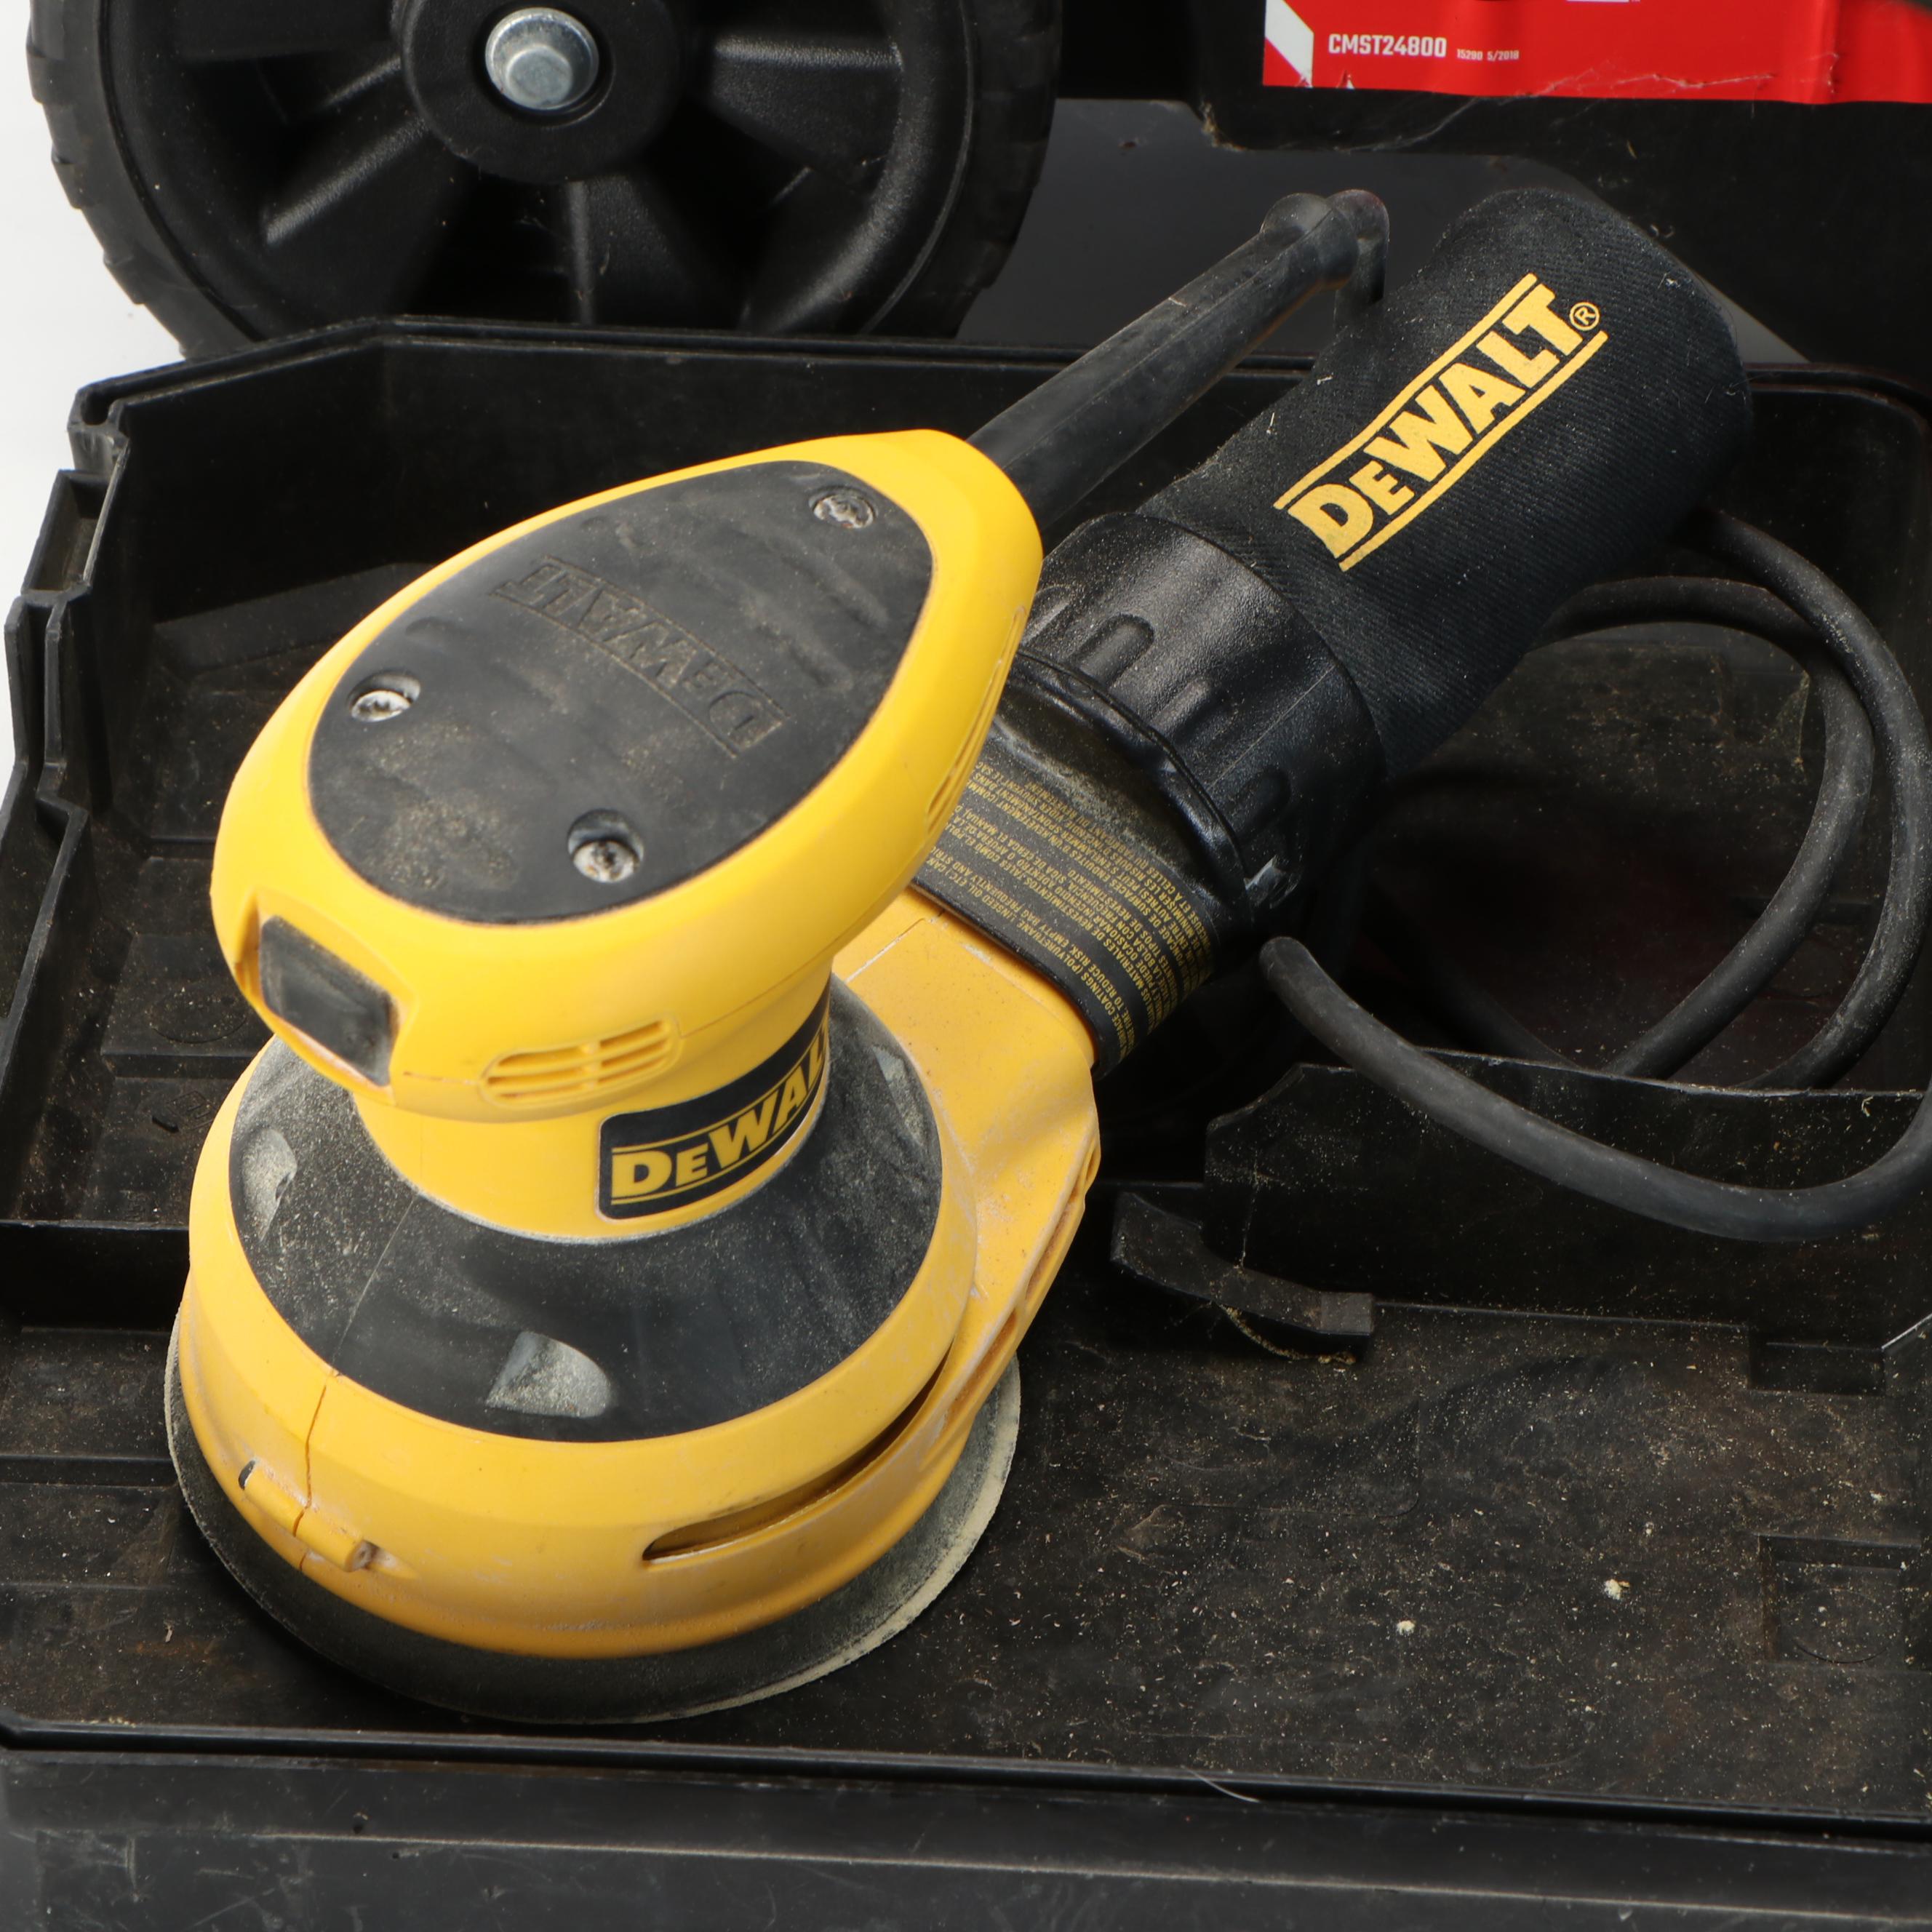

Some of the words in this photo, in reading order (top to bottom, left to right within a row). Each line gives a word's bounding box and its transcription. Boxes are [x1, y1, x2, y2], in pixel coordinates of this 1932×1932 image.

[1328, 33, 1447, 57] CMST24800
[953, 815, 965, 826] LA
[964, 823, 977, 834] DE
[964, 836, 975, 846] EL
[975, 831, 1008, 855] AFUERA
[996, 831, 1008, 842] EL
[925, 856, 946, 873] CAN
[952, 861, 973, 877] AND
[999, 859, 1024, 879] TALES
[1033, 856, 1047, 869] DE
[1045, 866, 1067, 883] SIGA
[1069, 849, 1110, 882] ENDUITES
[1109, 853, 1146, 881] RISQUES
[1117, 871, 1141, 890] PEUT
[1143, 877, 1161, 894] LES
[1146, 866, 1176, 894] CELLES
[970, 874, 1021, 913] FREQUENTLY
[1053, 885, 1095, 918] INCENDIO
[1109, 878, 1151, 916] SURFACES
[1138, 887, 1172, 922] AUTRES)
[981, 893, 1017, 922] LINSEED
[1021, 909, 1039, 925] BAG
[1158, 892, 1195, 938] MINIMISER
[1178, 900, 1191, 913] ET
[1115, 919, 1135, 940] CON
[1128, 918, 1143, 931] DE
[1147, 913, 1161, 927] DE
[1039, 922, 1069, 948] EMPTY
[1090, 927, 1105, 941] DE
[1092, 914, 1138, 961] OCASIONAR
[1139, 930, 1162, 955] TIPOS
[1167, 921, 1188, 949] ENTRE
[1102, 938, 1145, 989] MATERIALES
[1132, 938, 1156, 967] BOLSA
[1087, 963, 1117, 997] REDUCE
[1135, 959, 1156, 988] PUEDE
[1079, 971, 1117, 1015] COATINGS
[1113, 995, 1125, 1010] TO
[611, 1031, 823, 1199] DEWAL
